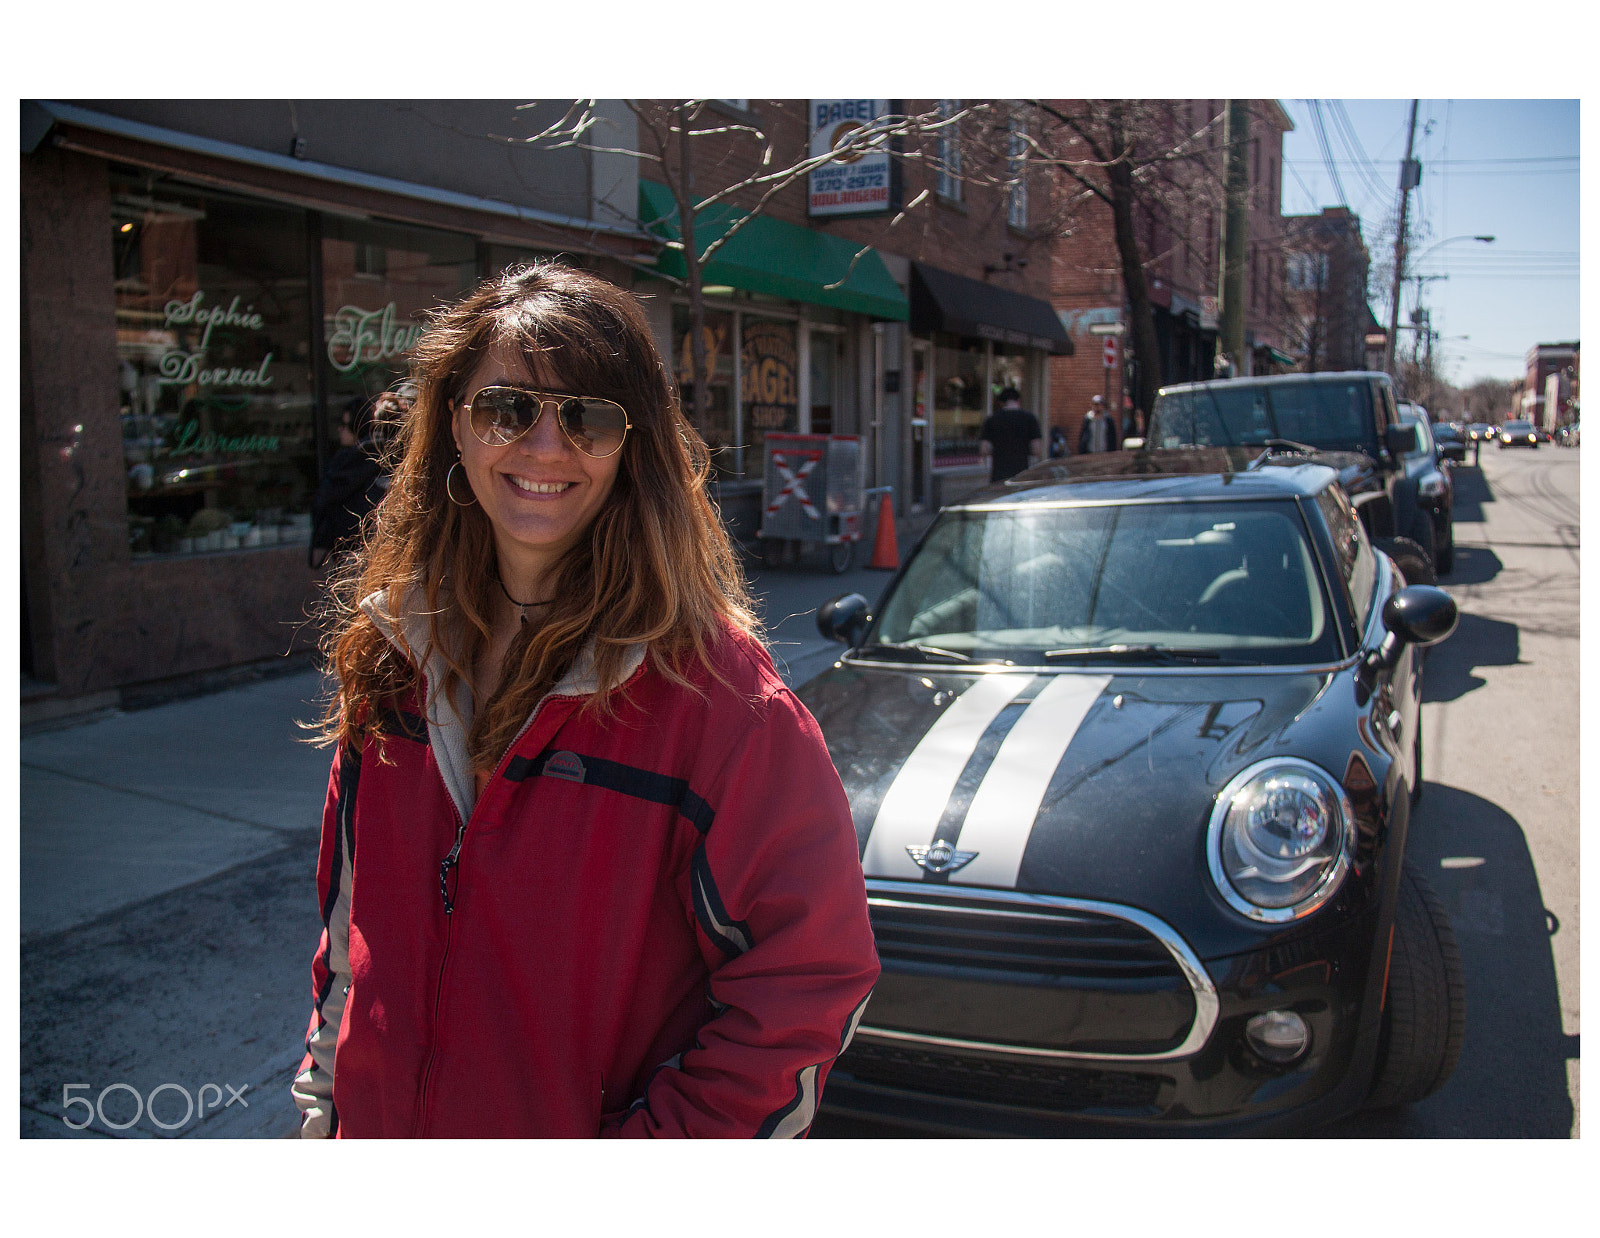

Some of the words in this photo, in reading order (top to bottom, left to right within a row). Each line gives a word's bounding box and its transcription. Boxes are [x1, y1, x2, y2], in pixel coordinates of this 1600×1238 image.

[816, 99, 882, 128] BAGEL
[815, 174, 884, 192] 270-2972
[810, 187, 888, 207] BOULANGERIE
[164, 290, 264, 350] Sophie
[327, 300, 424, 372] Fleu
[751, 404, 787, 428] SHOP
[928, 850, 951, 860] MINI
